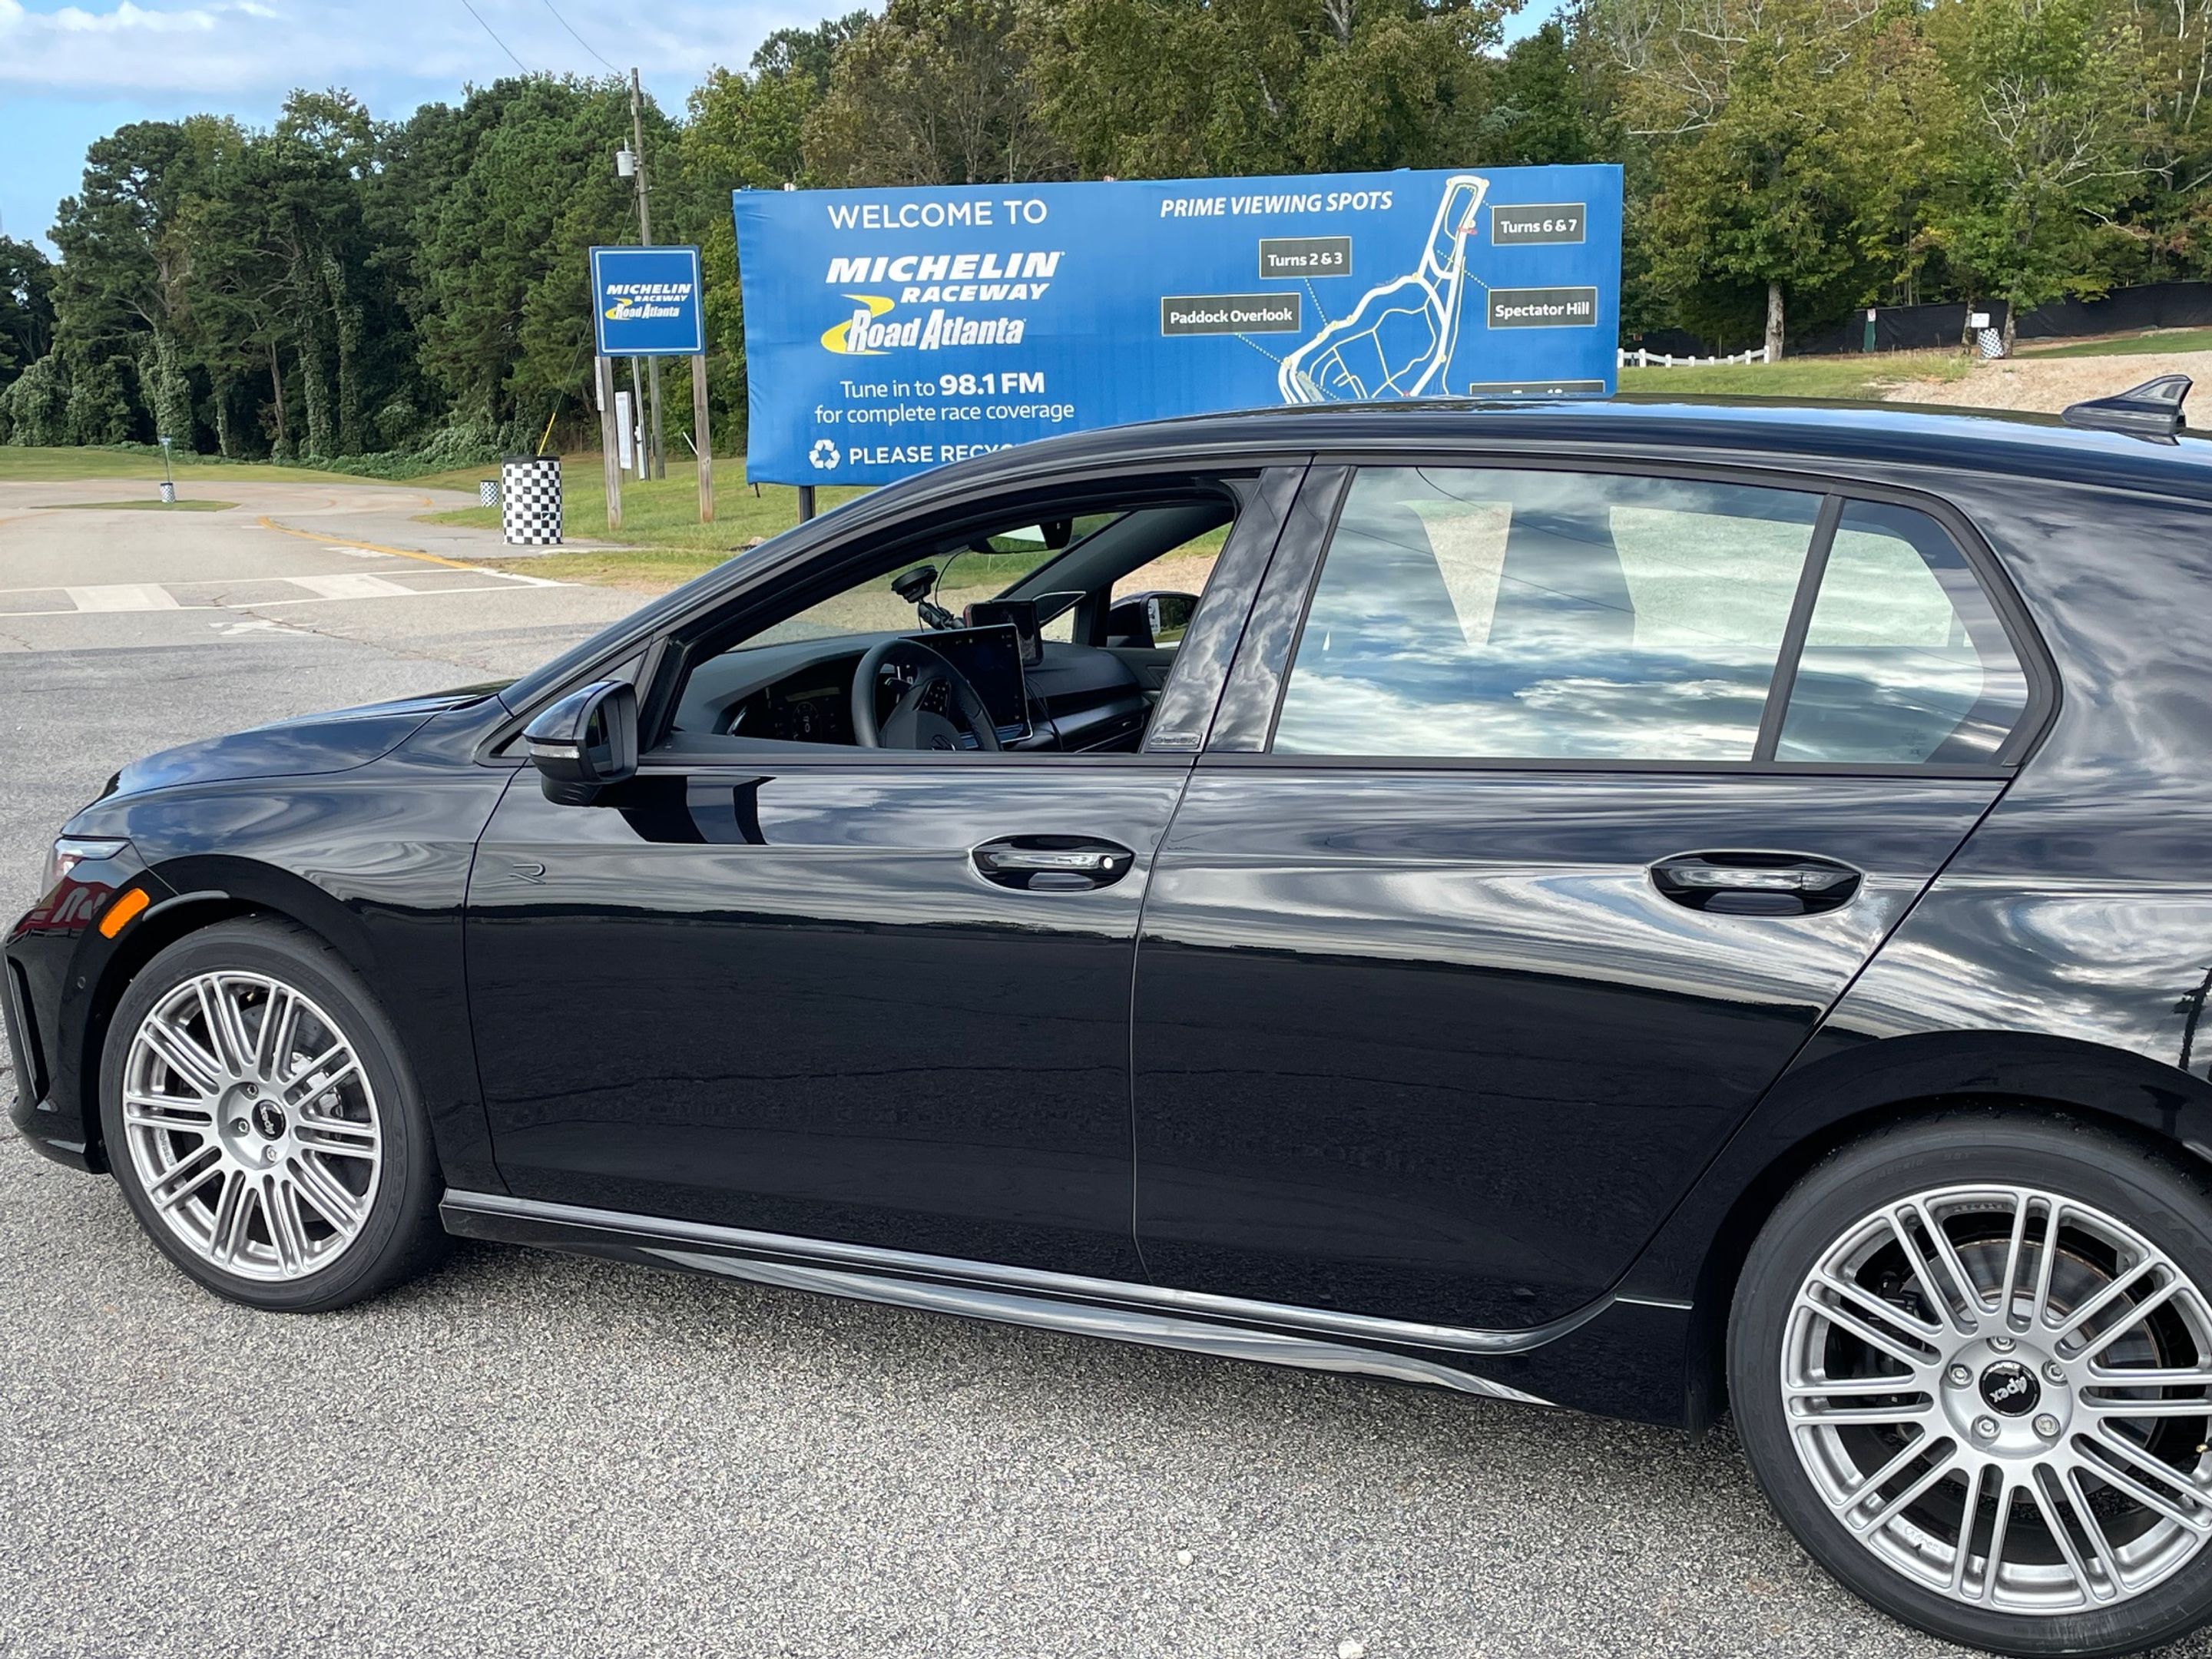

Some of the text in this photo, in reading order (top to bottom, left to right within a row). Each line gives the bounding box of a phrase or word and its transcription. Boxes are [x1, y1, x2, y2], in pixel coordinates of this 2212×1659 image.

[827, 199, 1048, 230] WELCOME TO
[1161, 190, 1393, 218] PRIME VIEWING SPOTS
[1500, 219, 1578, 234] Turns 6 & 7
[826, 251, 1061, 283] MICHELIN
[1267, 252, 1343, 267] Turns 2 & 3
[606, 283, 692, 295] MICHELIN
[900, 283, 1050, 303] RACEWAY
[615, 303, 680, 319] Road Atlanta
[1171, 307, 1293, 324] Paddock Overlook
[1495, 301, 1590, 320] Spectator Hill
[846, 309, 1025, 353] Road Atlanta
[840, 372, 1045, 398] Tune in to 98.1 FM
[815, 403, 1074, 426] for complete race coverage
[849, 445, 933, 465] PLEASE
[508, 863, 547, 885] R
[1988, 1376, 2028, 1403] Apex
